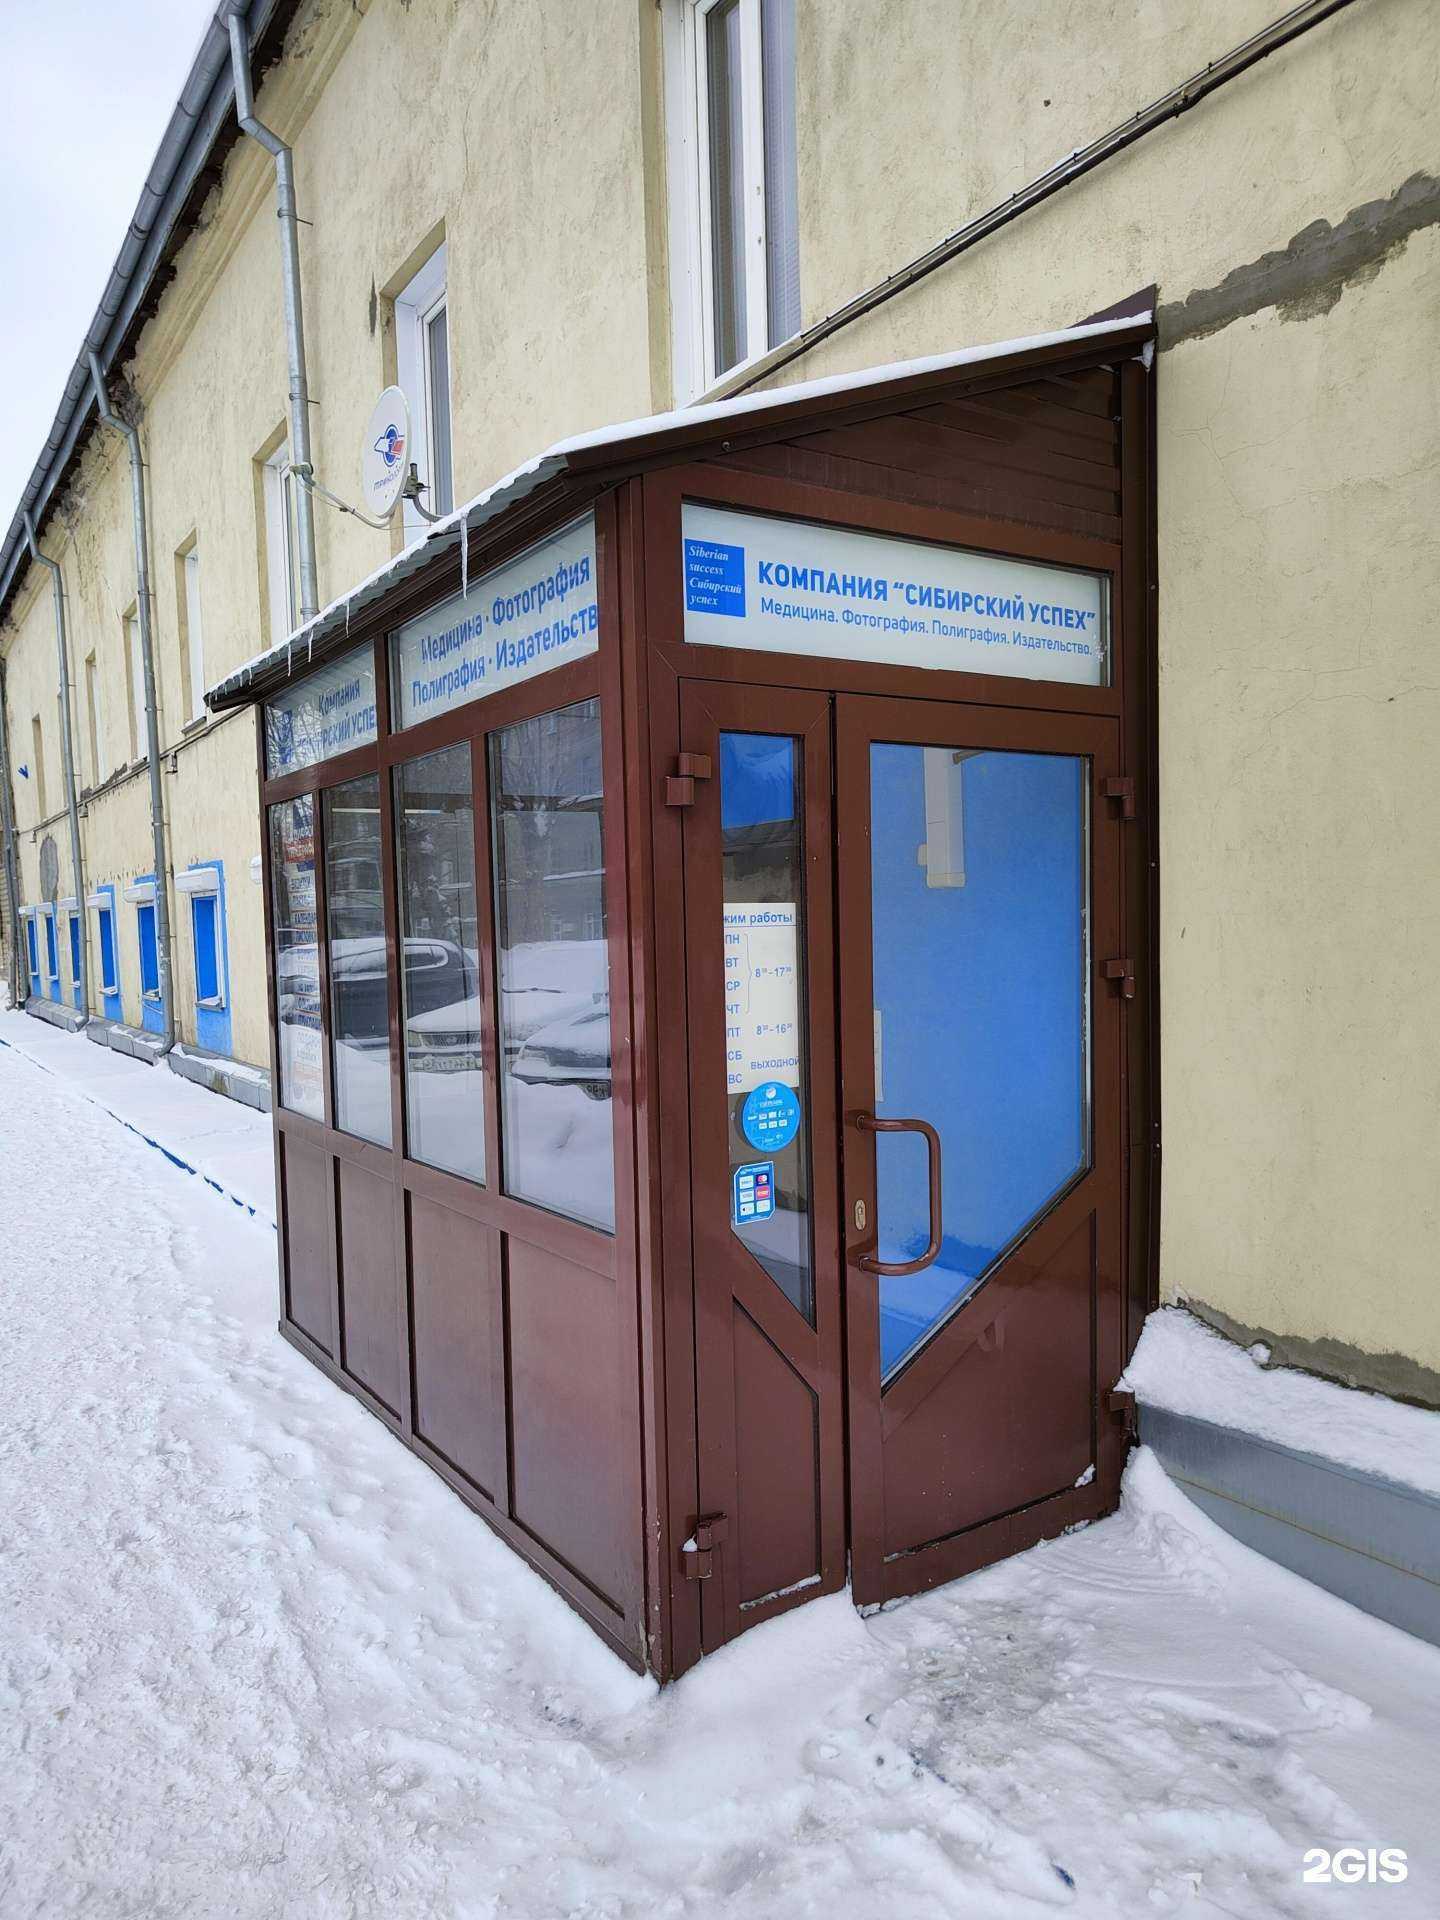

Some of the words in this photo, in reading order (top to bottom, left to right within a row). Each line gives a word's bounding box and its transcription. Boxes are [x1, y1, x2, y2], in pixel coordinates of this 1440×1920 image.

[688, 545, 729, 561] Siberian
[689, 563, 724, 576] success
[689, 577, 742, 595] Сибирский
[758, 560, 888, 601] КОМПАНИЯ
[689, 594, 719, 606] успех
[421, 613, 483, 665] Медицина
[492, 556, 590, 626] Фотография
[761, 597, 839, 623] Медицина.
[842, 608, 929, 634] Фотография.
[932, 619, 1010, 645] Полиграфия.
[1013, 631, 1093, 656] Издательство.
[412, 655, 485, 708] Полиграфия
[750, 911, 793, 926] работы
[725, 934, 740, 945] ПН
[725, 957, 739, 968] ВТ
[726, 980, 740, 991] СР
[726, 1004, 741, 1015] ЧТ
[727, 1027, 741, 1038] ПТ
[727, 1050, 742, 1061] СБ
[728, 1074, 743, 1085] ВС
